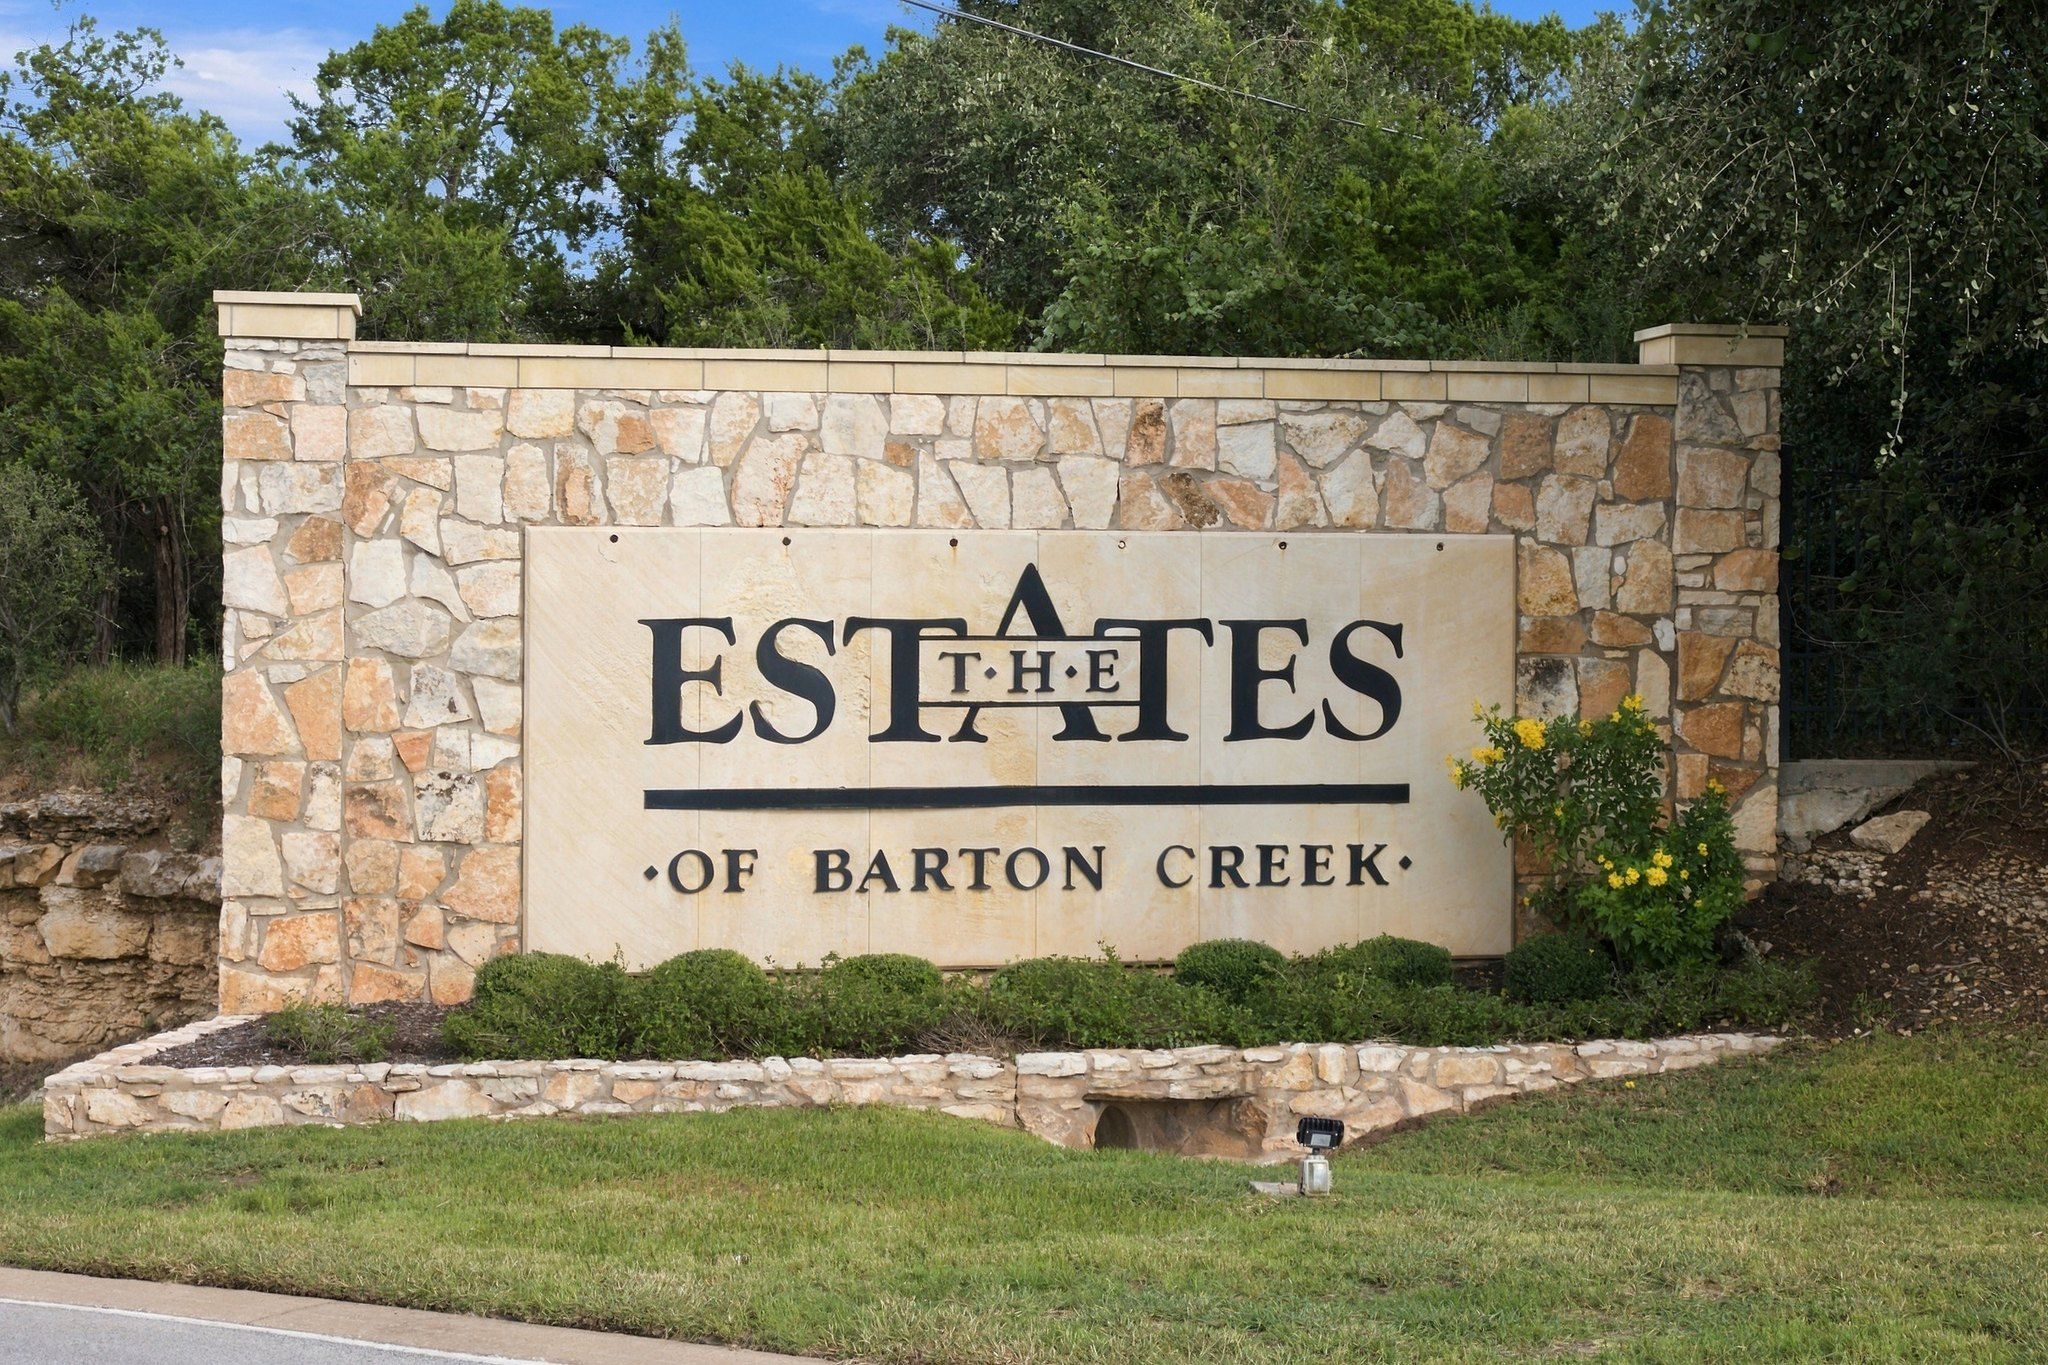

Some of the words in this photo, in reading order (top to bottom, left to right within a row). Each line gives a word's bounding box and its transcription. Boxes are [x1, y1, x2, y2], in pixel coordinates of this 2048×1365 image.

[637, 562, 1404, 746] ESTATES
[667, 848, 759, 894] OF
[812, 845, 1106, 894] BARTON
[1155, 843, 1390, 889] CREEK
